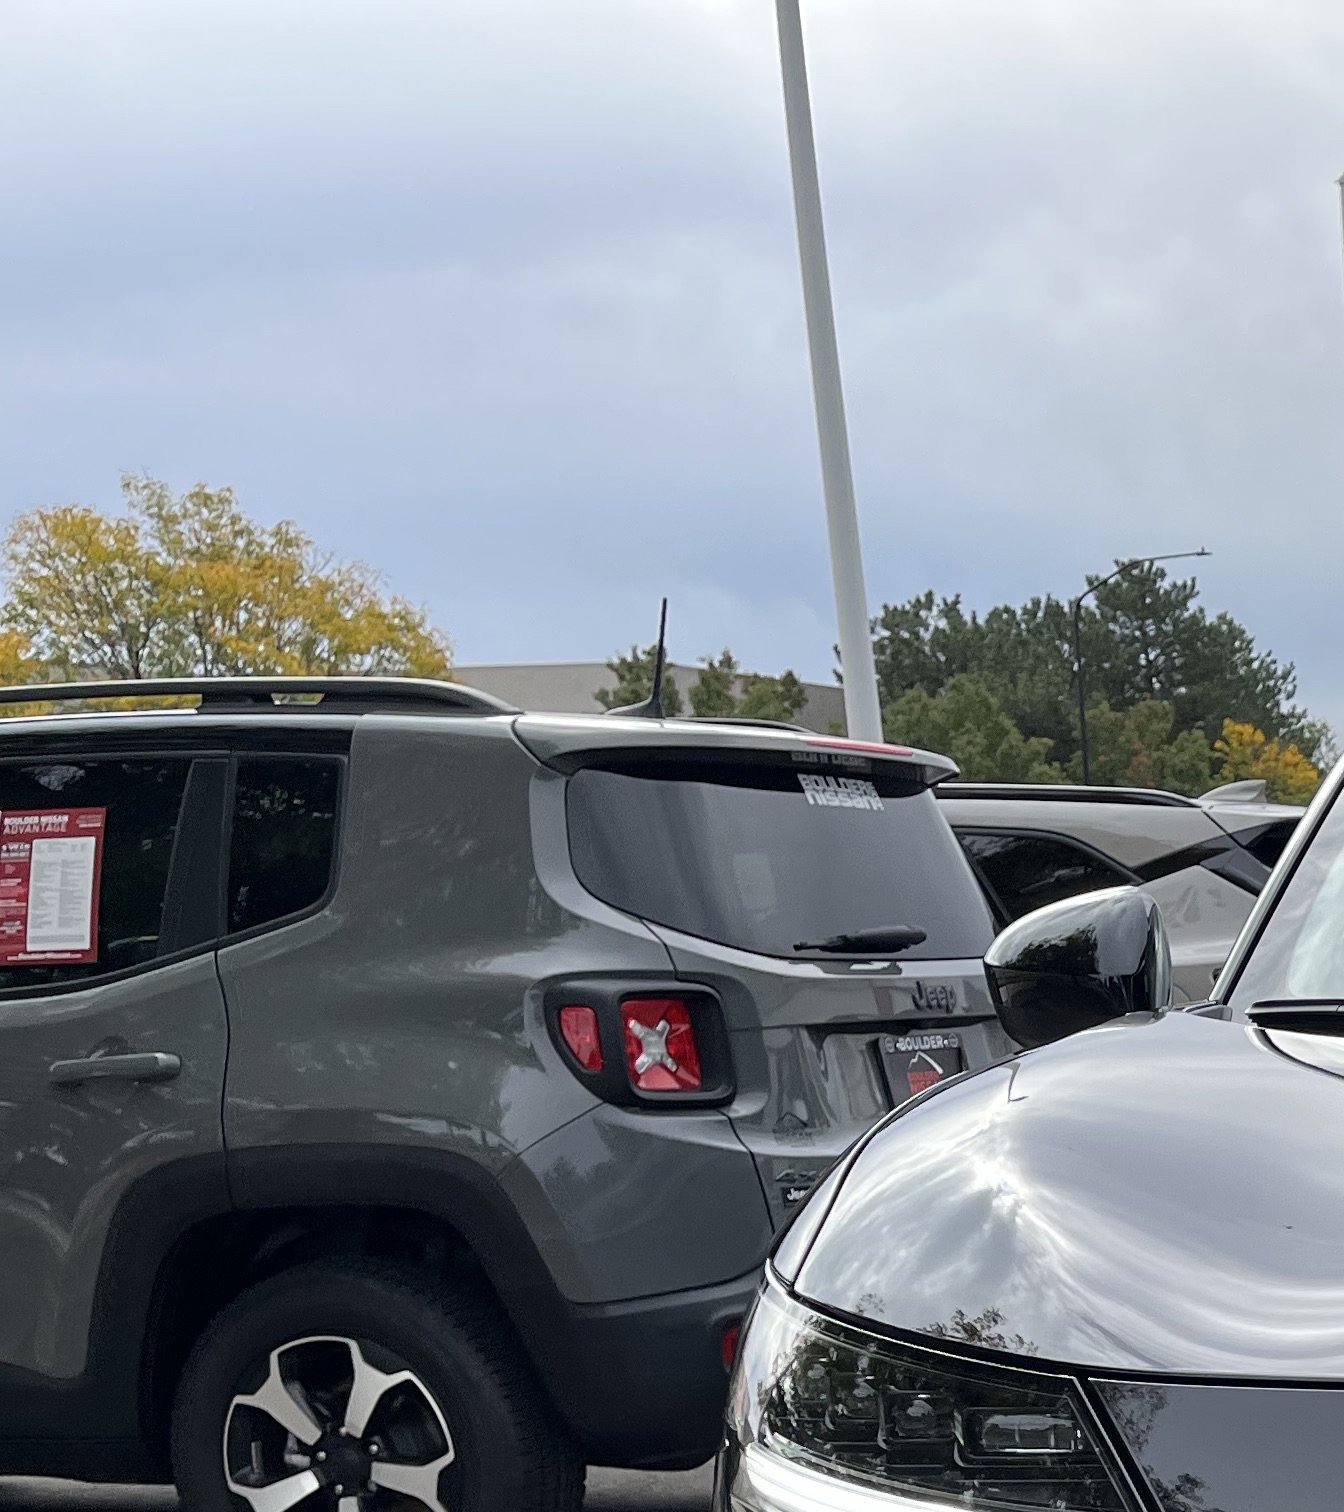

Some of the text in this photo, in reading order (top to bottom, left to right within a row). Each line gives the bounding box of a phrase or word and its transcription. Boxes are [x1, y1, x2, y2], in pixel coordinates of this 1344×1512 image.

[911, 980, 957, 1014] Jeep
[898, 1035, 944, 1051] BOULDER
[786, 1187, 807, 1201] Jee
